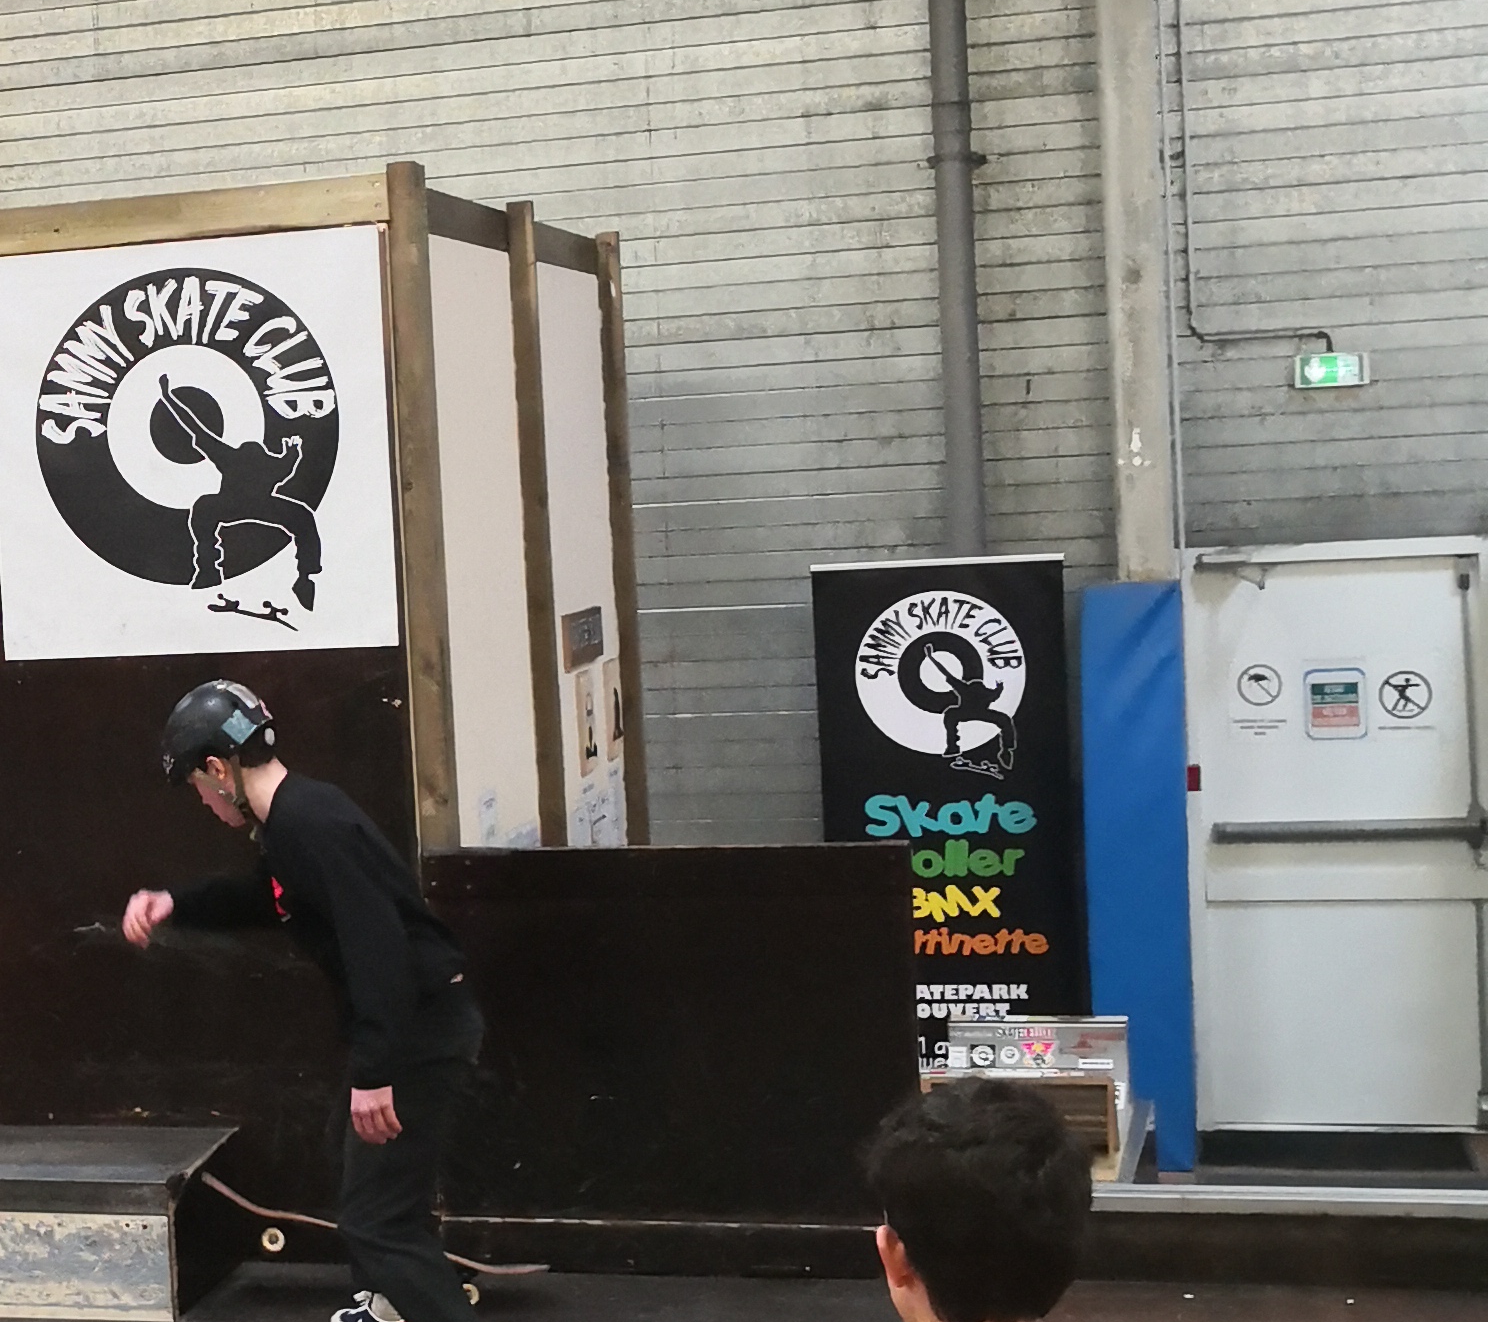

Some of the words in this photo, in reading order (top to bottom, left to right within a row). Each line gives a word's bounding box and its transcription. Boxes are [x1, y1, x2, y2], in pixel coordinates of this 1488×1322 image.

[40, 305, 135, 444] SAMMY
[123, 276, 265, 348] SKATE
[242, 317, 336, 419] CLUB
[858, 609, 912, 680] SAMMY
[907, 596, 984, 631] SKATE
[974, 618, 1023, 670] CLUB
[864, 793, 1038, 838] Skate
[912, 839, 1026, 878] oller
[914, 927, 1050, 956] ttinette
[915, 984, 1029, 1000] ATEPARK
[916, 1003, 1010, 1019] OUVERT
